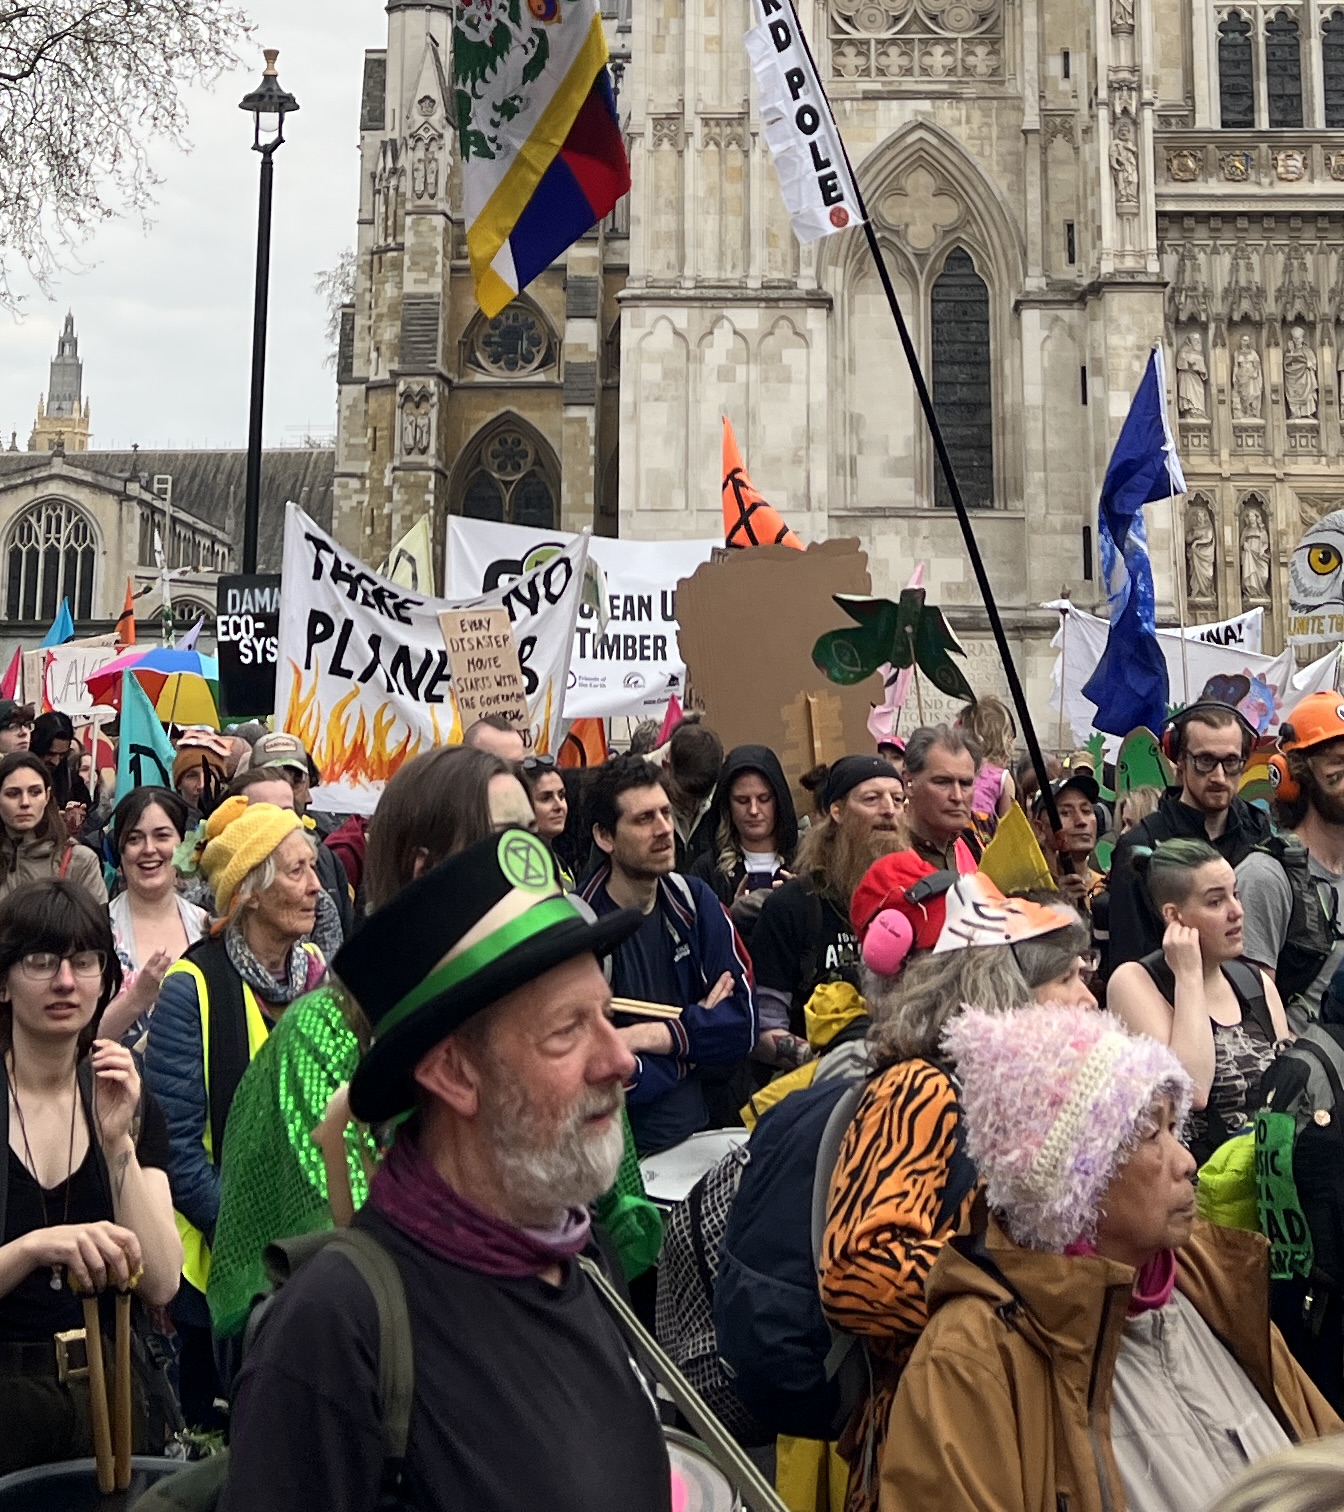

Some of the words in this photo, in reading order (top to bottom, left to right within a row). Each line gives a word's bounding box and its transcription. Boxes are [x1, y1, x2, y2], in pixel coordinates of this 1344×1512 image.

[785, 66, 844, 206] POLE
[305, 531, 425, 626] THERE
[502, 556, 573, 621] NO
[227, 587, 282, 614] DAMA
[217, 614, 265, 642] ECO-
[459, 617, 492, 633] EVERY
[1288, 615, 1325, 637] UNITE
[1328, 614, 1344, 634] TO
[239, 636, 278, 664] SYS
[305, 608, 452, 704] PLANE
[450, 634, 511, 653] DISASTER
[467, 655, 502, 673] MOVIE
[50, 655, 110, 706] WAK
[494, 673, 518, 688] WITH
[459, 695, 476, 710] THE
[1256, 1149, 1284, 1177] SIC
